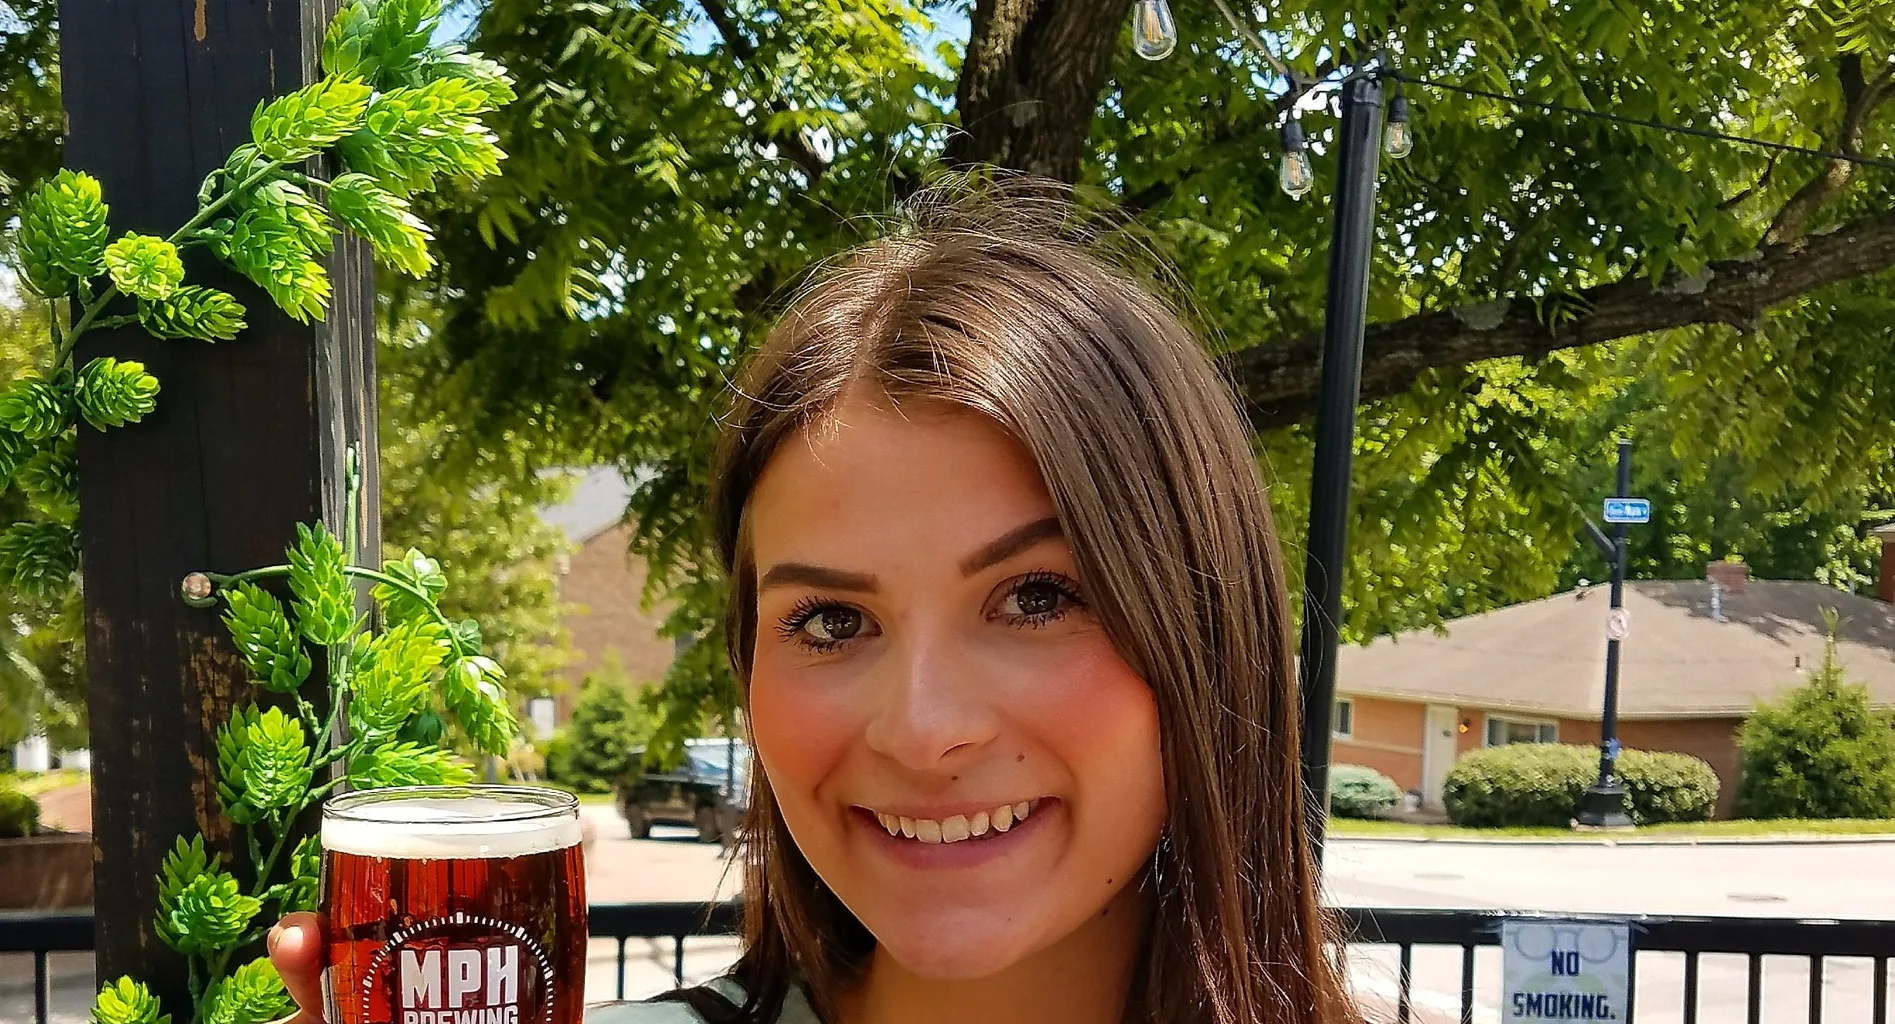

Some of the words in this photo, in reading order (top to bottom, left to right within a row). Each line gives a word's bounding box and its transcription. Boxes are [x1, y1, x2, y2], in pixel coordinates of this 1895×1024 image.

[401, 945, 518, 1009] MPH
[1551, 950, 1580, 976] NO
[1513, 992, 1616, 1020] SMOKING.
